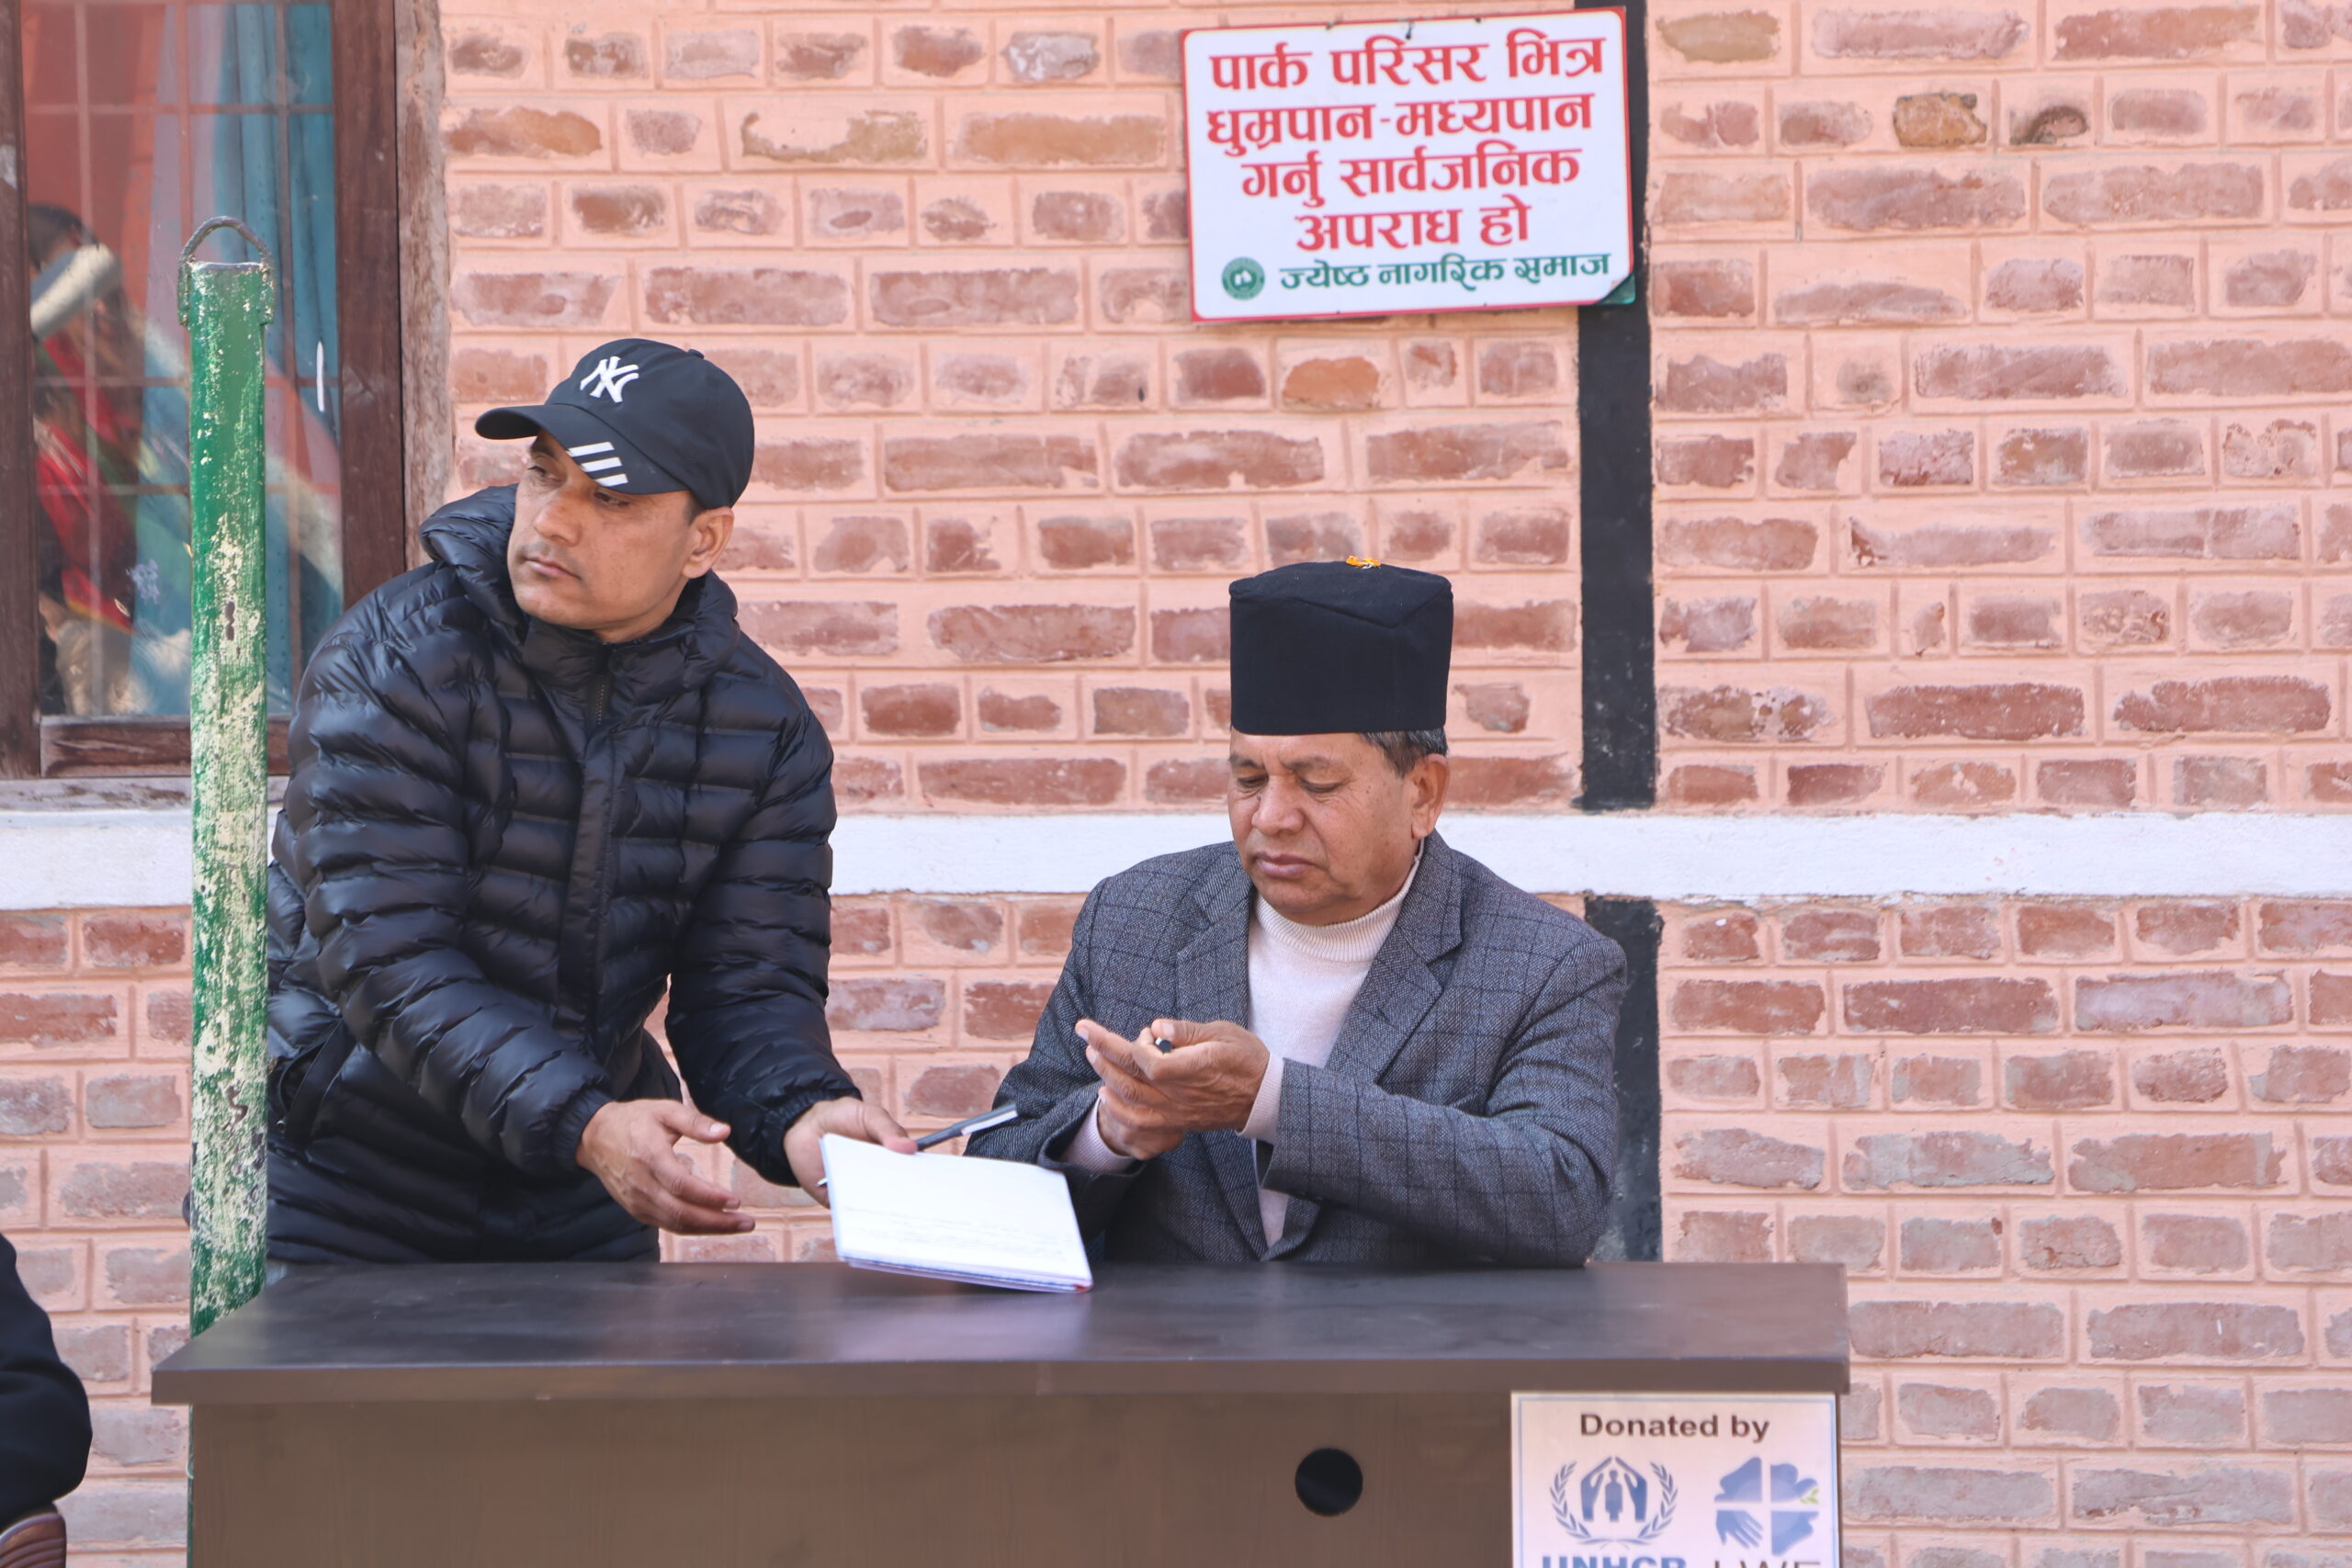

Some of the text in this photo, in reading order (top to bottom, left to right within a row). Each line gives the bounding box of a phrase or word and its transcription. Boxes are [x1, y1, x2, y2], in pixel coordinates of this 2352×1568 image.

[1208, 27, 1606, 90] पार्क परिसर भित्र
[1240, 139, 1583, 209] गर्नु सार्वजनिक
[1295, 193, 1532, 252] अपराध हो
[1279, 253, 1611, 291] ज्येष्ठ नागरिक समाज
[1580, 1414, 1770, 1443] Donated by
